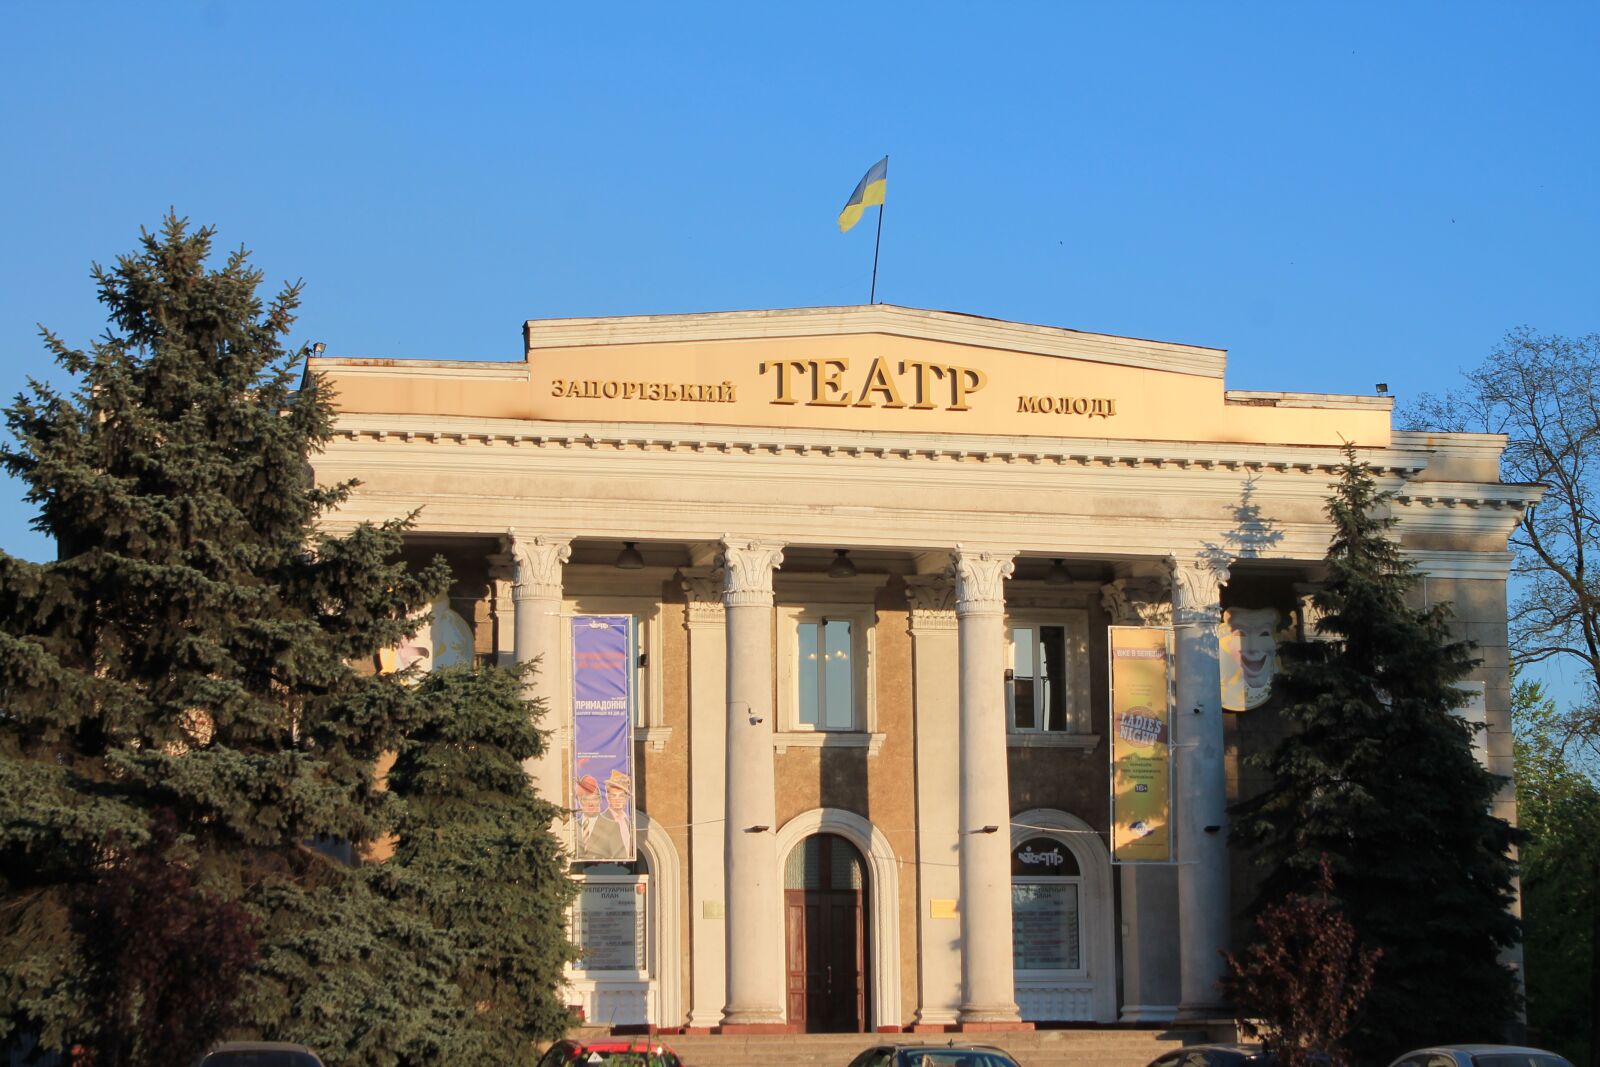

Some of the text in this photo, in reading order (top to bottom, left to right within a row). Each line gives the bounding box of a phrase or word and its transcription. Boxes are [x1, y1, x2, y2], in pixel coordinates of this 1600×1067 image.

[551, 355, 1117, 419] ЗАПОРІЗЬКИЙ ТЕАТР МОЛОДІ
[1120, 725, 1158, 746] NIGHT
